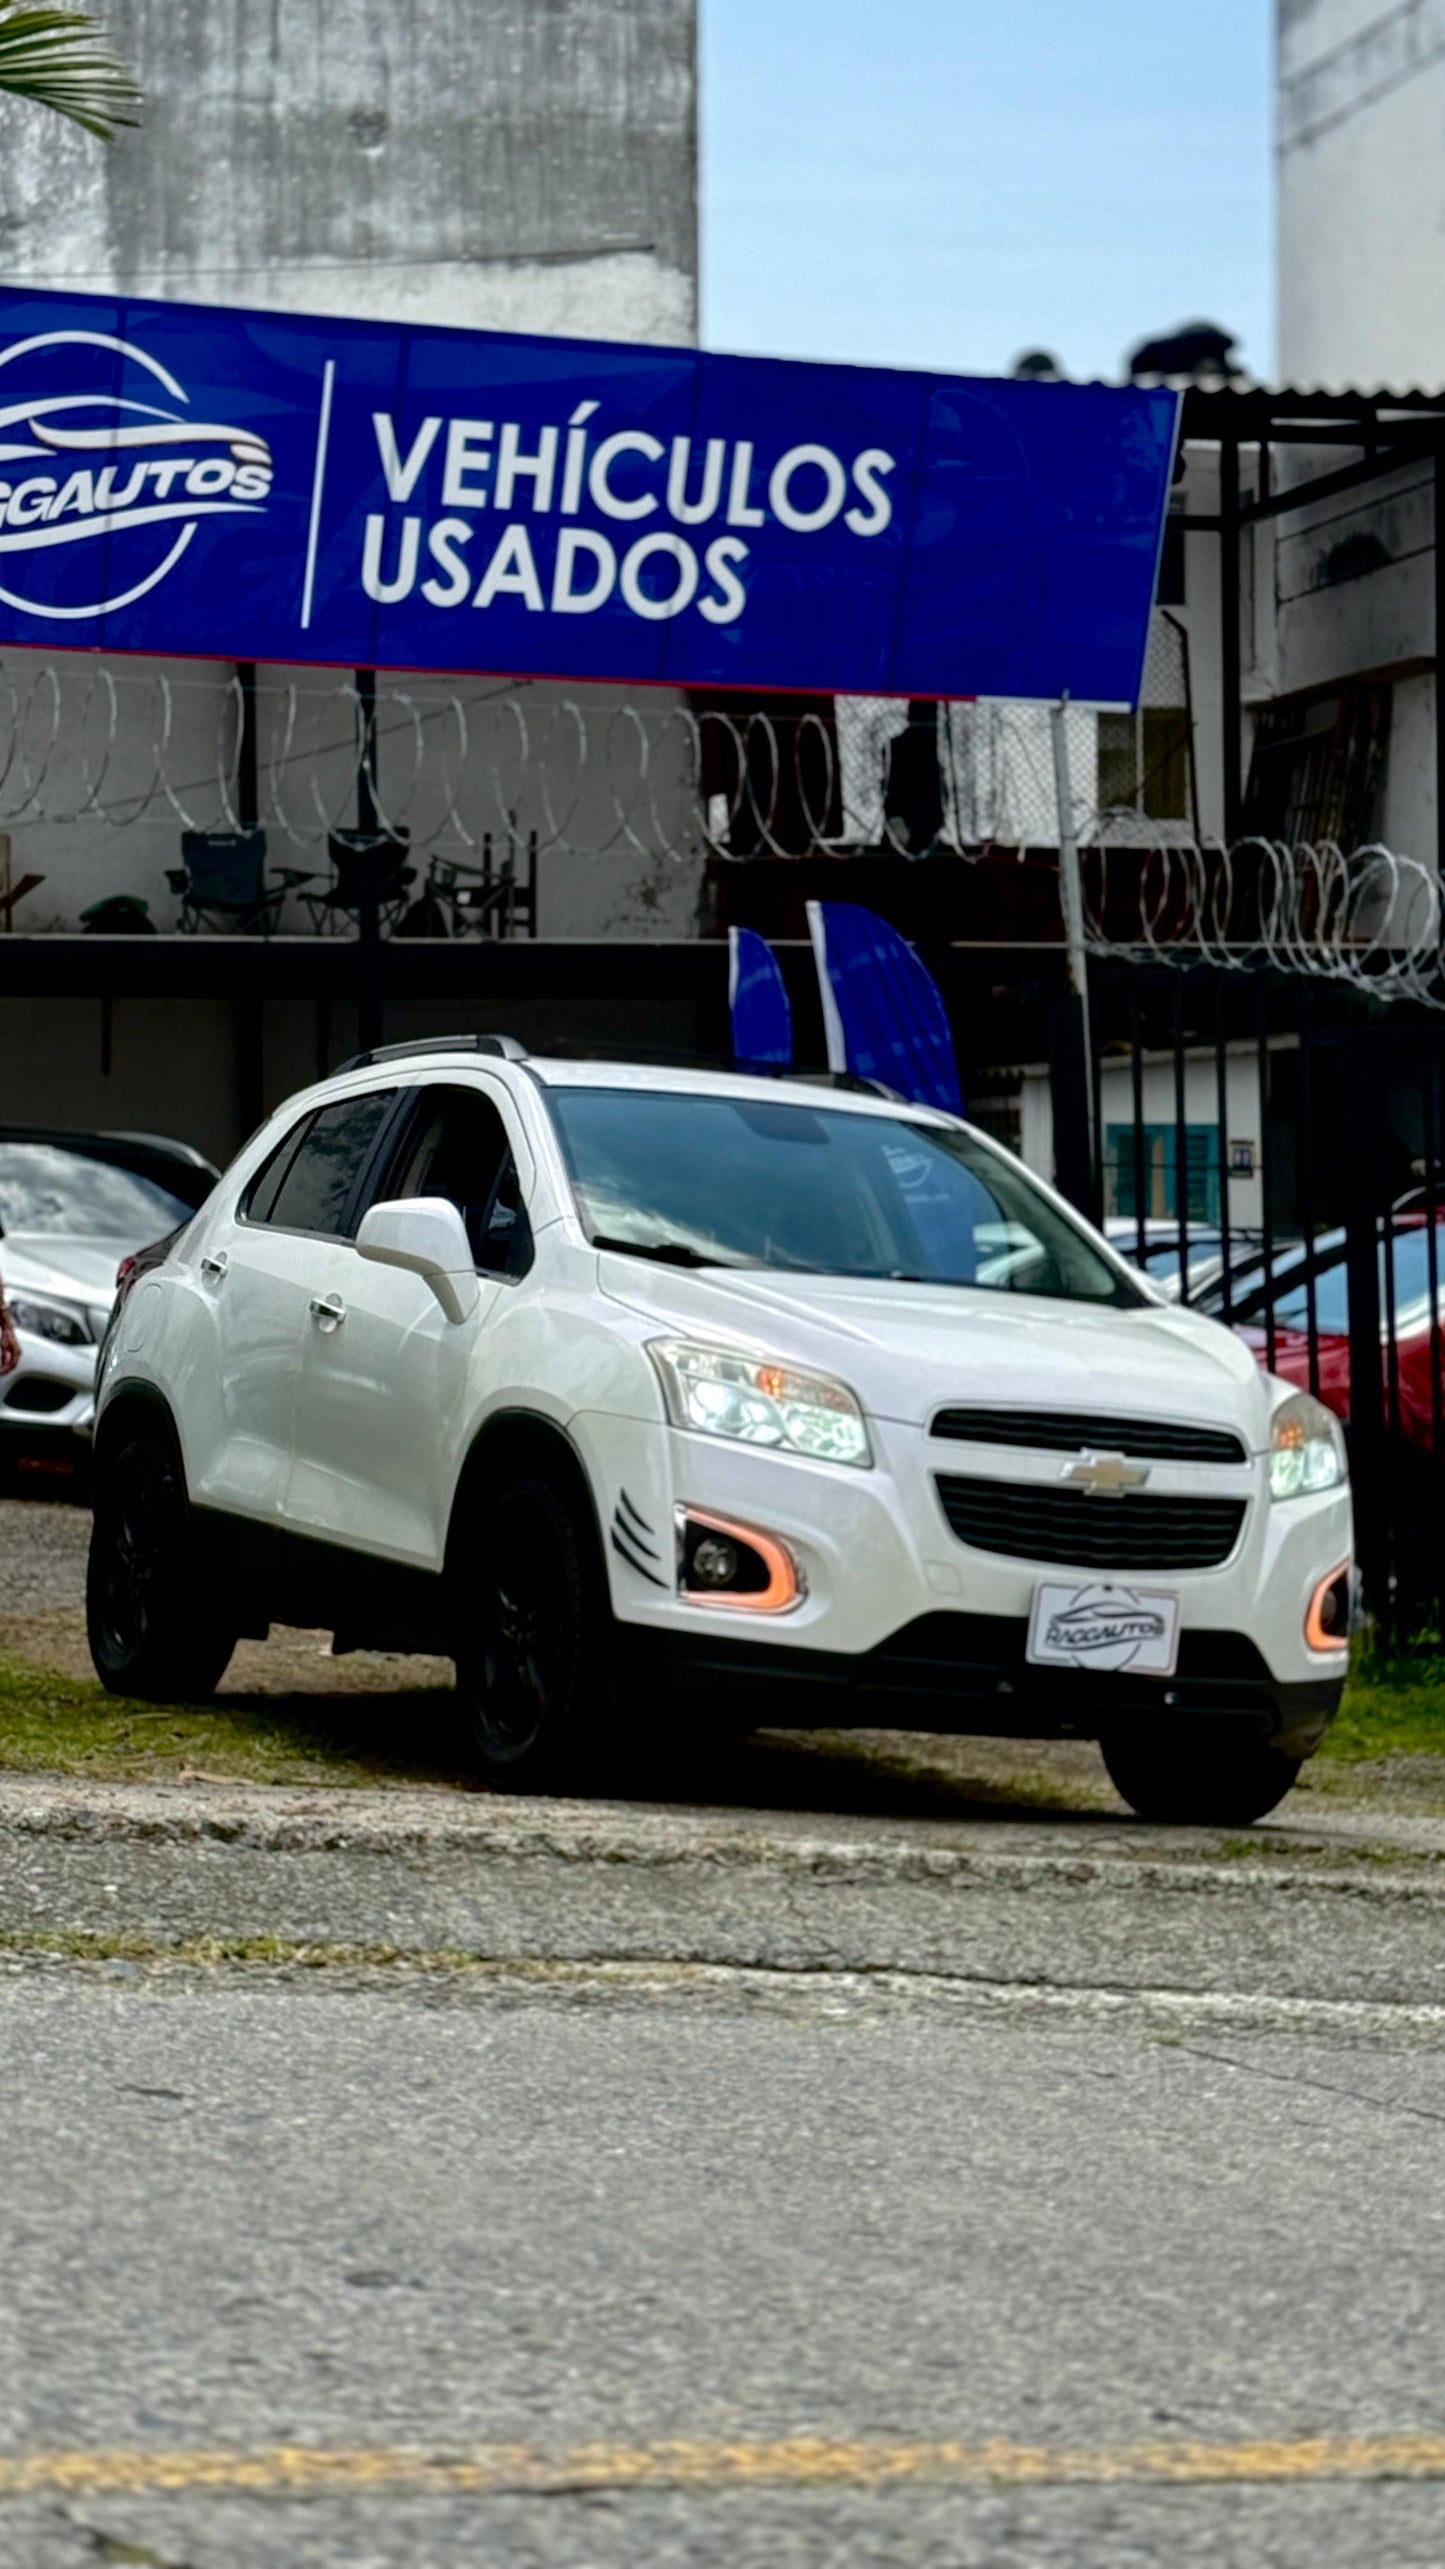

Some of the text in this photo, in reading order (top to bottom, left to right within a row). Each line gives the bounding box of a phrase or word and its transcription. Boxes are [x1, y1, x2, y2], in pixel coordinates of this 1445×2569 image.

[0, 459, 273, 528] GAUTOS
[372, 401, 896, 536] VEHÍCULOS
[361, 514, 750, 625] USADOS
